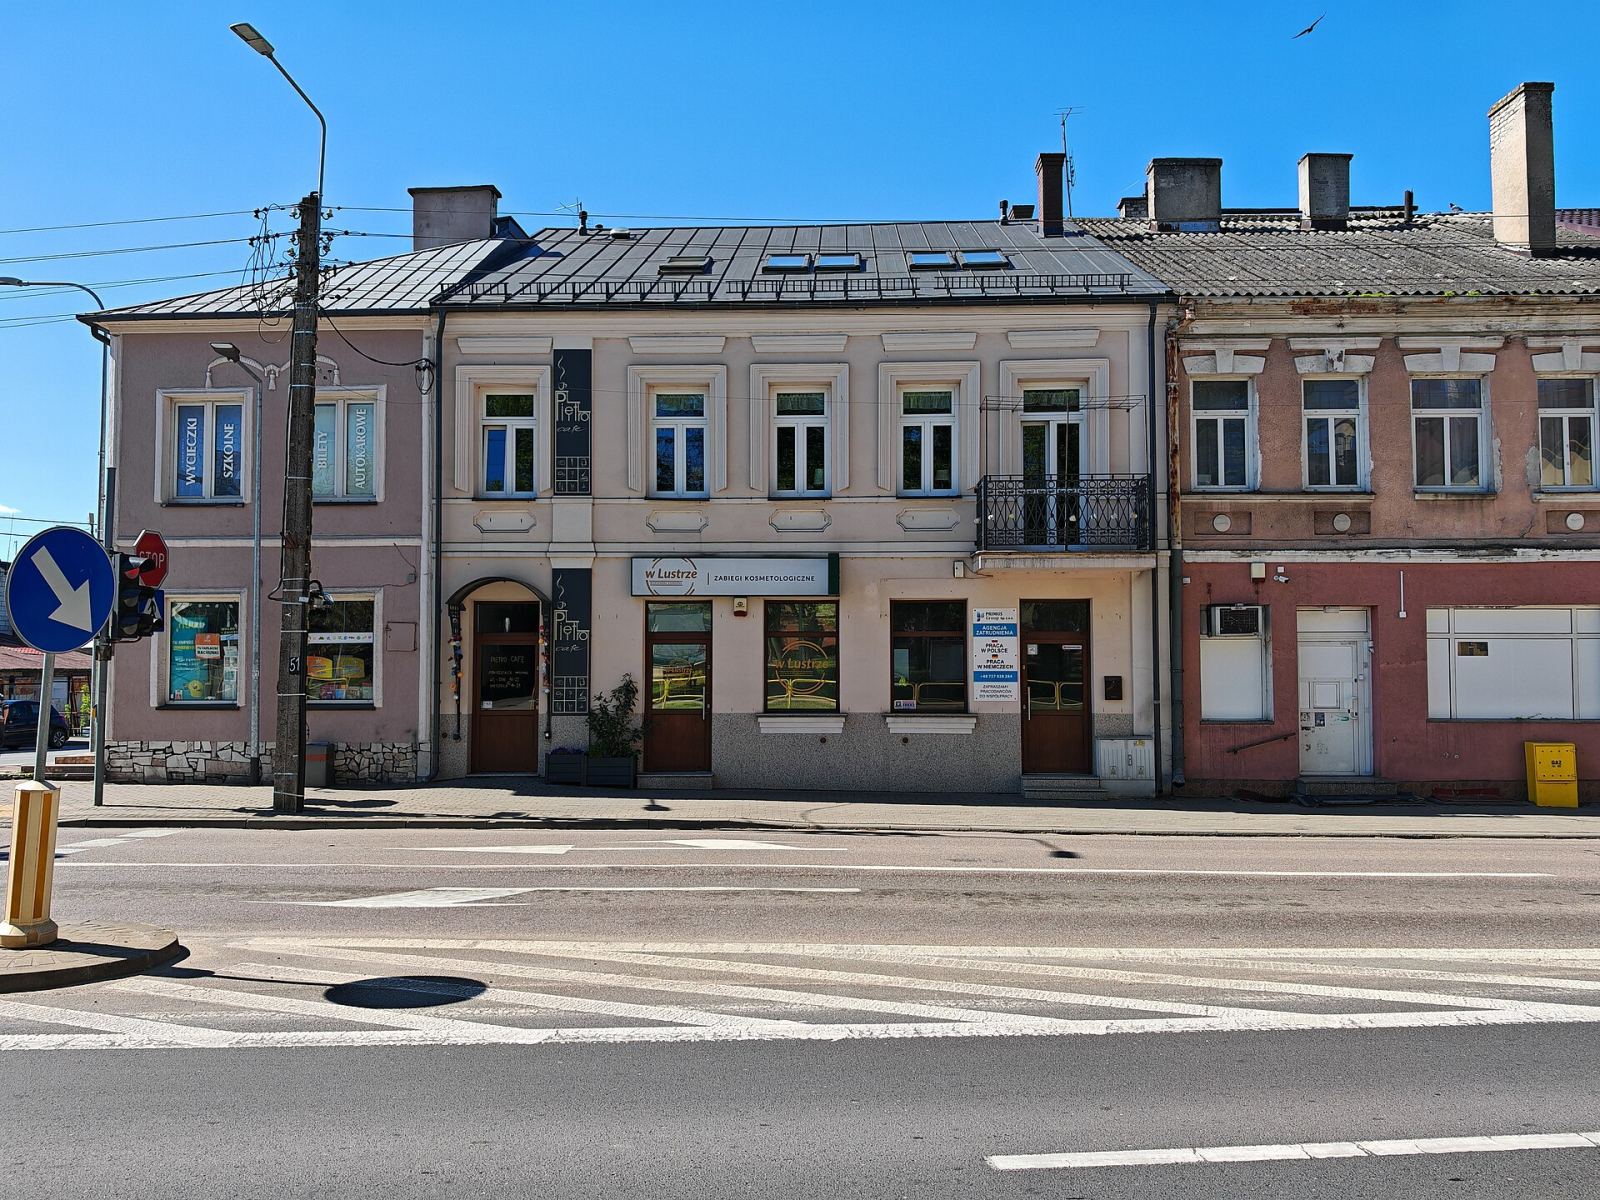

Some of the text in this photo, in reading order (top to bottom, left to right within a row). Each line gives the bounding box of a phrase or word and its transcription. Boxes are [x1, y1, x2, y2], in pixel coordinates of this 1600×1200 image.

[555, 391, 590, 421] Pietro
[185, 417, 198, 486] WYCIECZKI
[223, 423, 235, 478] SZKOLNE
[317, 430, 328, 470] BILETY
[355, 408, 367, 489] AUTOKAROWE
[645, 568, 698, 579] w Lustrze
[554, 610, 589, 641] Pietro
[289, 657, 300, 671] 51
[787, 657, 829, 669] Lustrze
